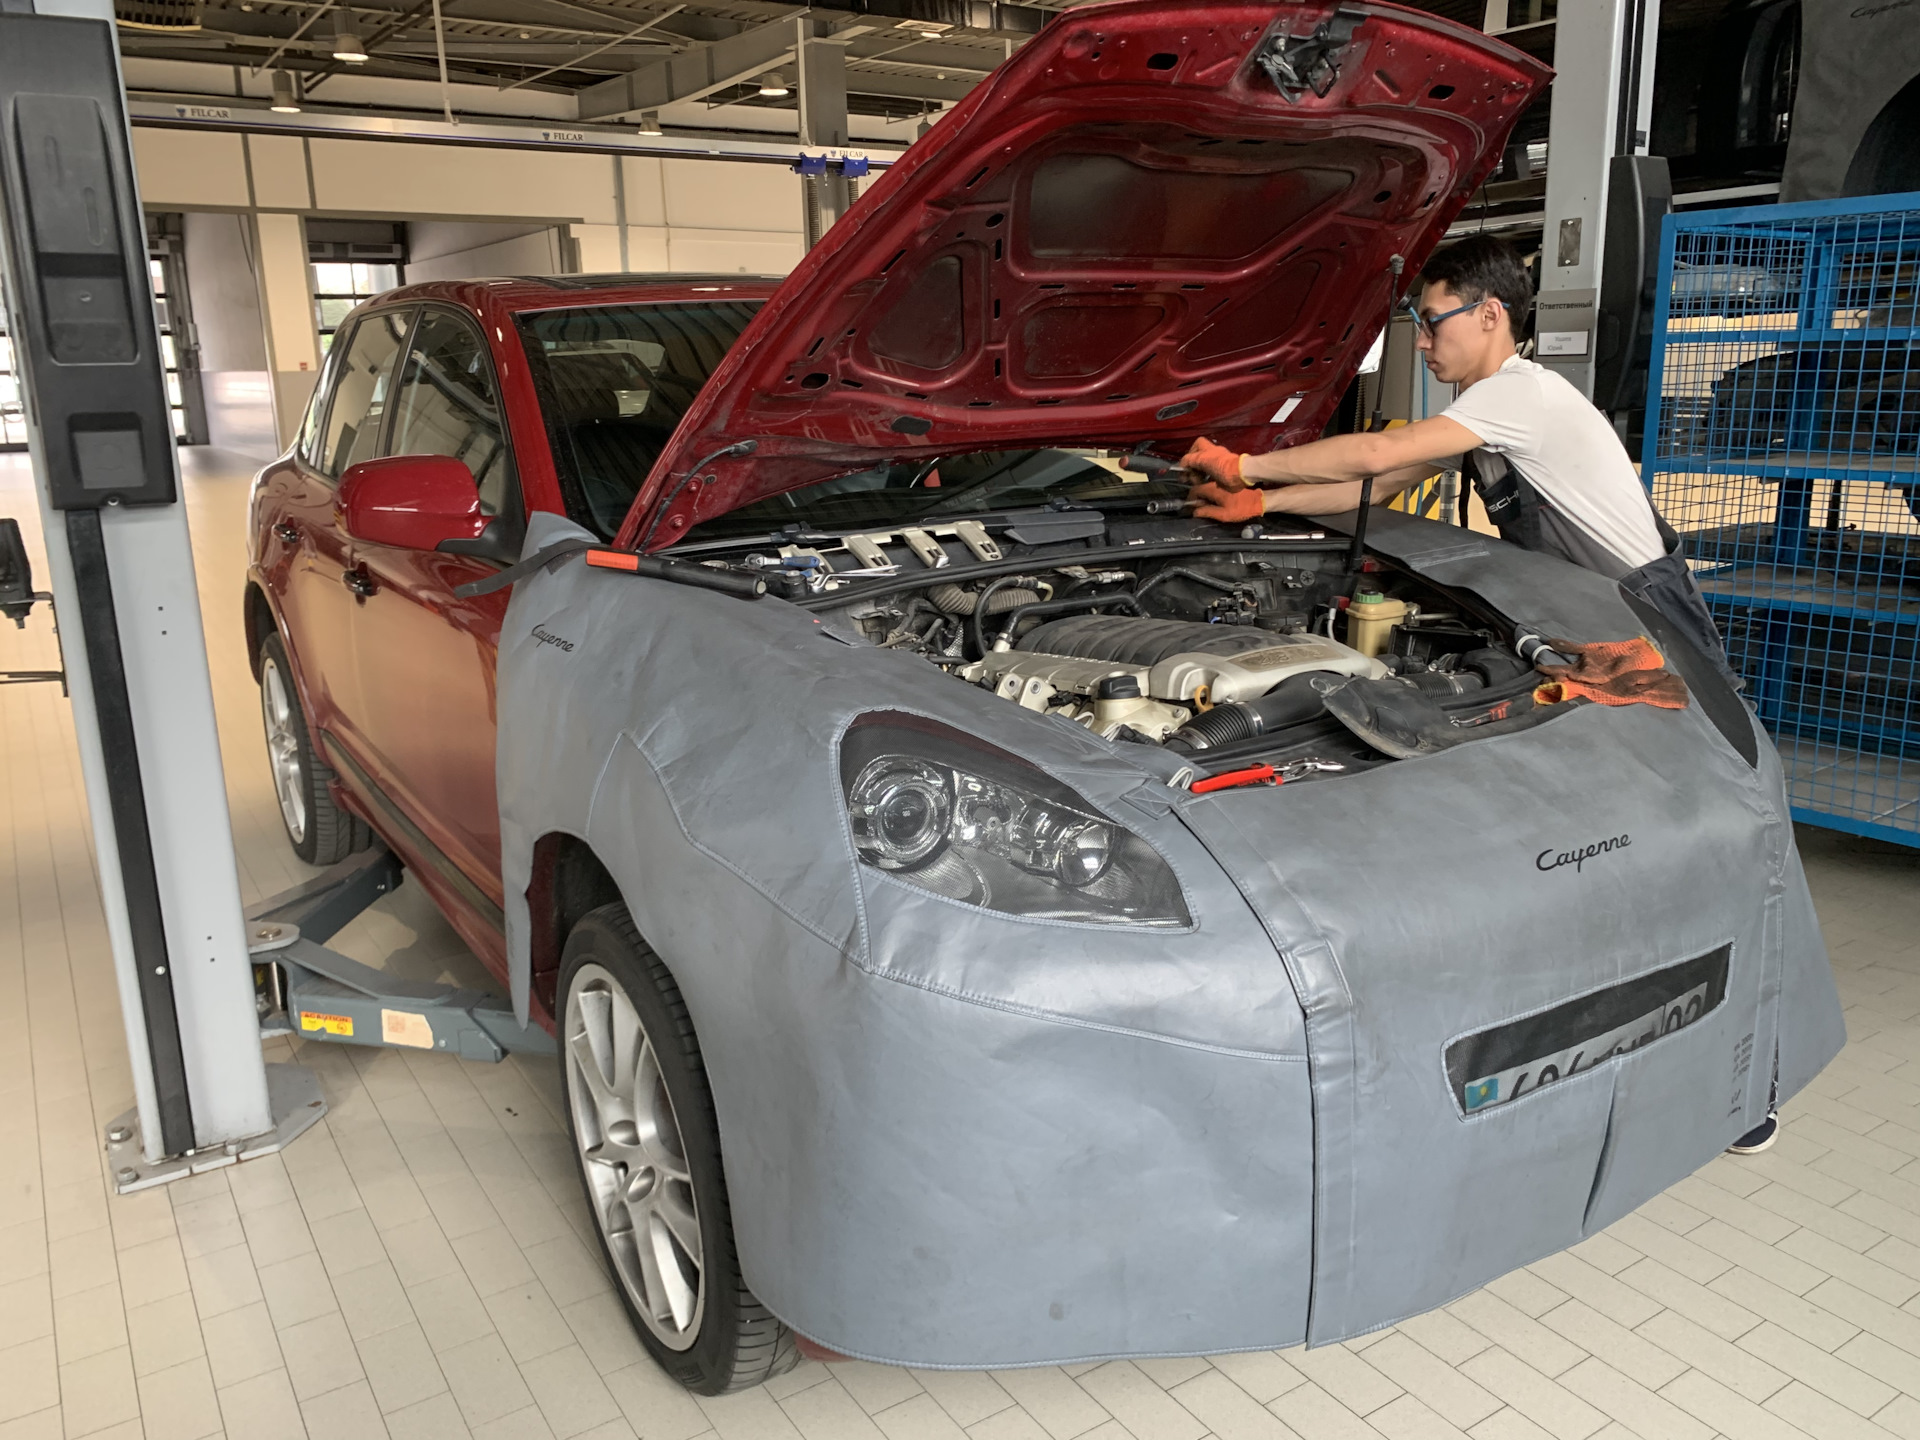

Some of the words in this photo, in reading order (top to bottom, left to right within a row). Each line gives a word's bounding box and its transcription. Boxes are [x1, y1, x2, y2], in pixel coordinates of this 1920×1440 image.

[190, 108, 230, 119] FILCAR
[553, 132, 584, 141] FILCAR
[839, 149, 864, 158] FILCAR
[1539, 300, 1593, 310] Ответственный
[531, 623, 575, 653] Cayenne
[1536, 833, 1632, 873] Cayenne
